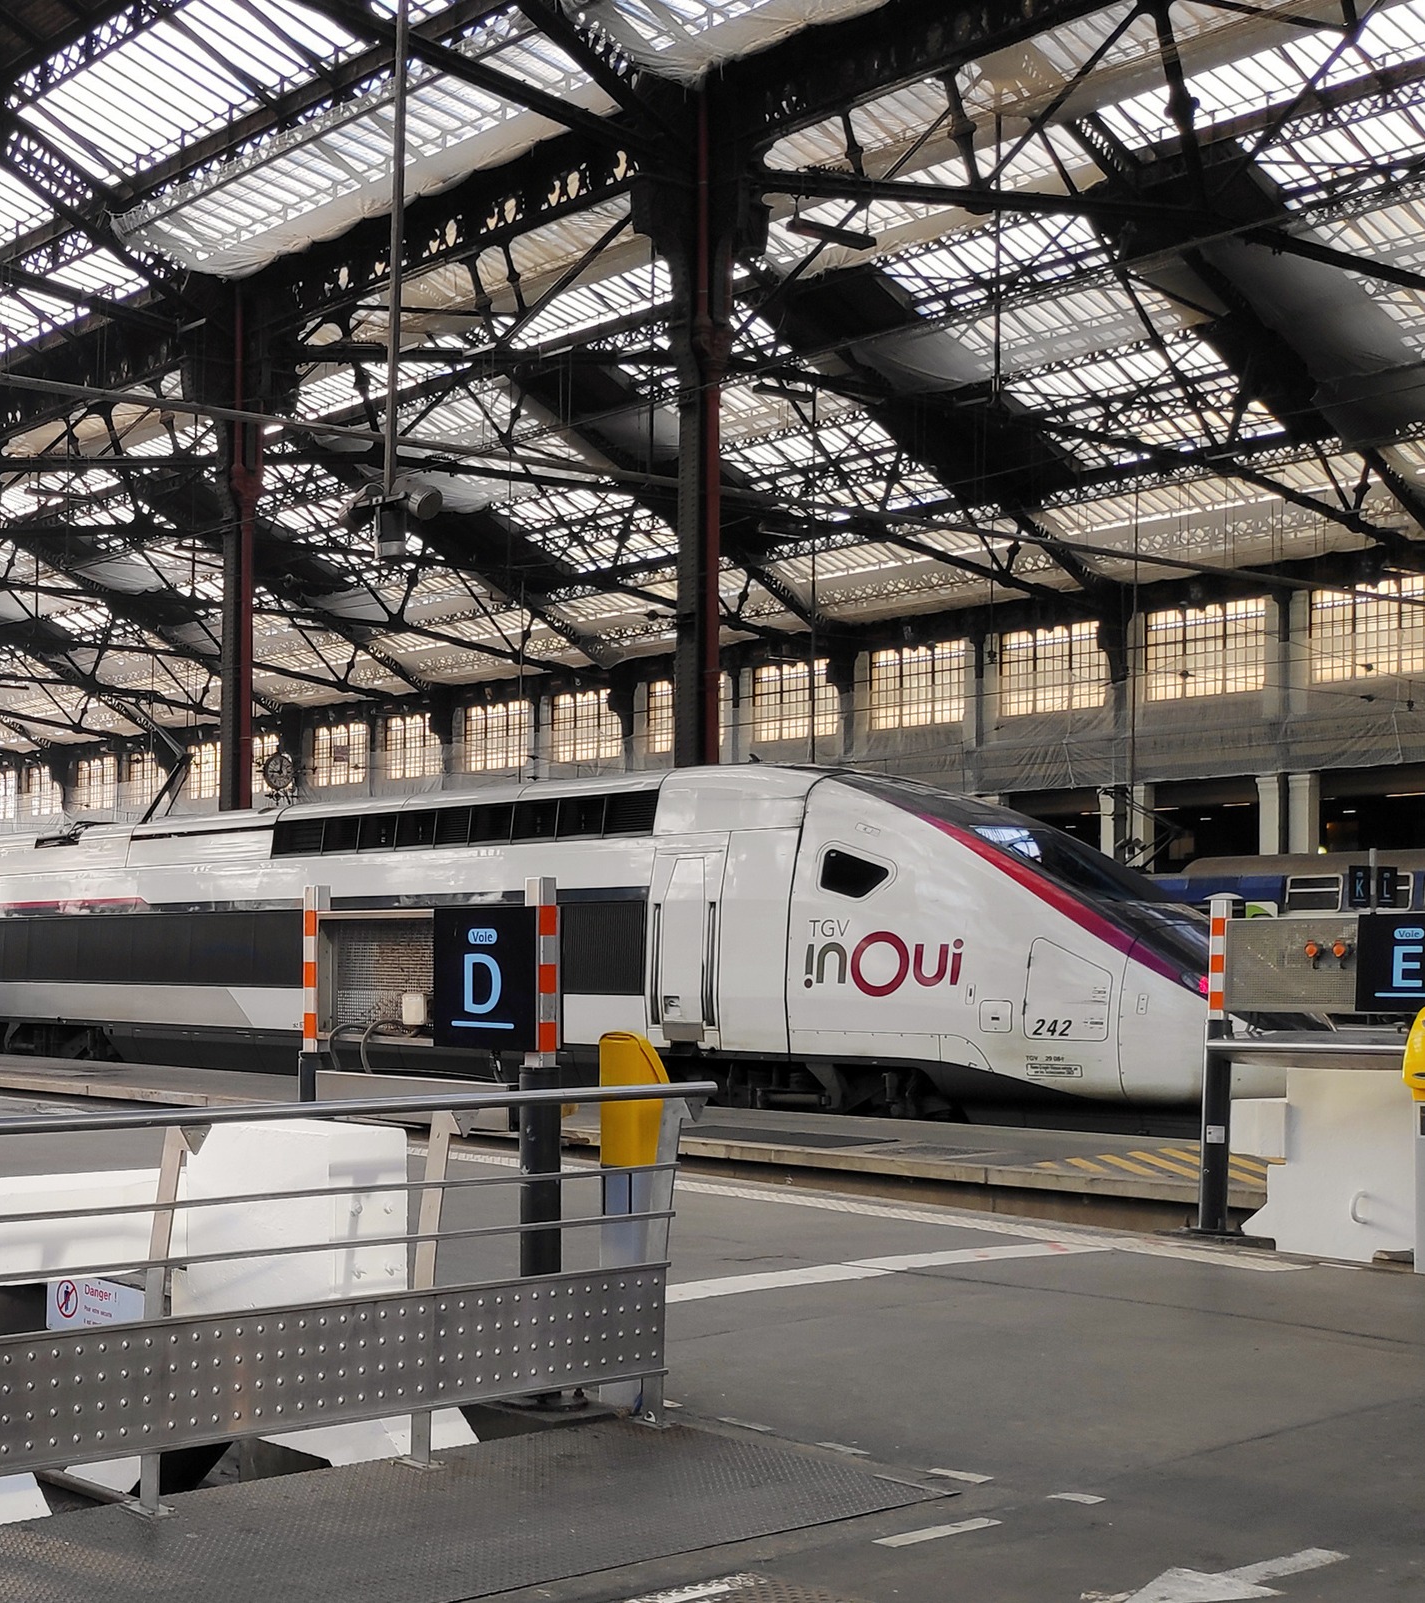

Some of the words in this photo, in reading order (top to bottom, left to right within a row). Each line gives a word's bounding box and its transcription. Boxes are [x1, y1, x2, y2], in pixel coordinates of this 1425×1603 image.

[1355, 880, 1364, 898] K
[1383, 880, 1390, 898] L
[471, 931, 493, 943] Voie
[808, 919, 850, 937] TGV
[1398, 930, 1420, 938] Voie
[1392, 945, 1423, 988] E
[464, 953, 502, 1014] D
[1032, 1018, 1073, 1037] 242
[84, 1284, 111, 1301] Danger
[114, 1292, 117, 1303] !
